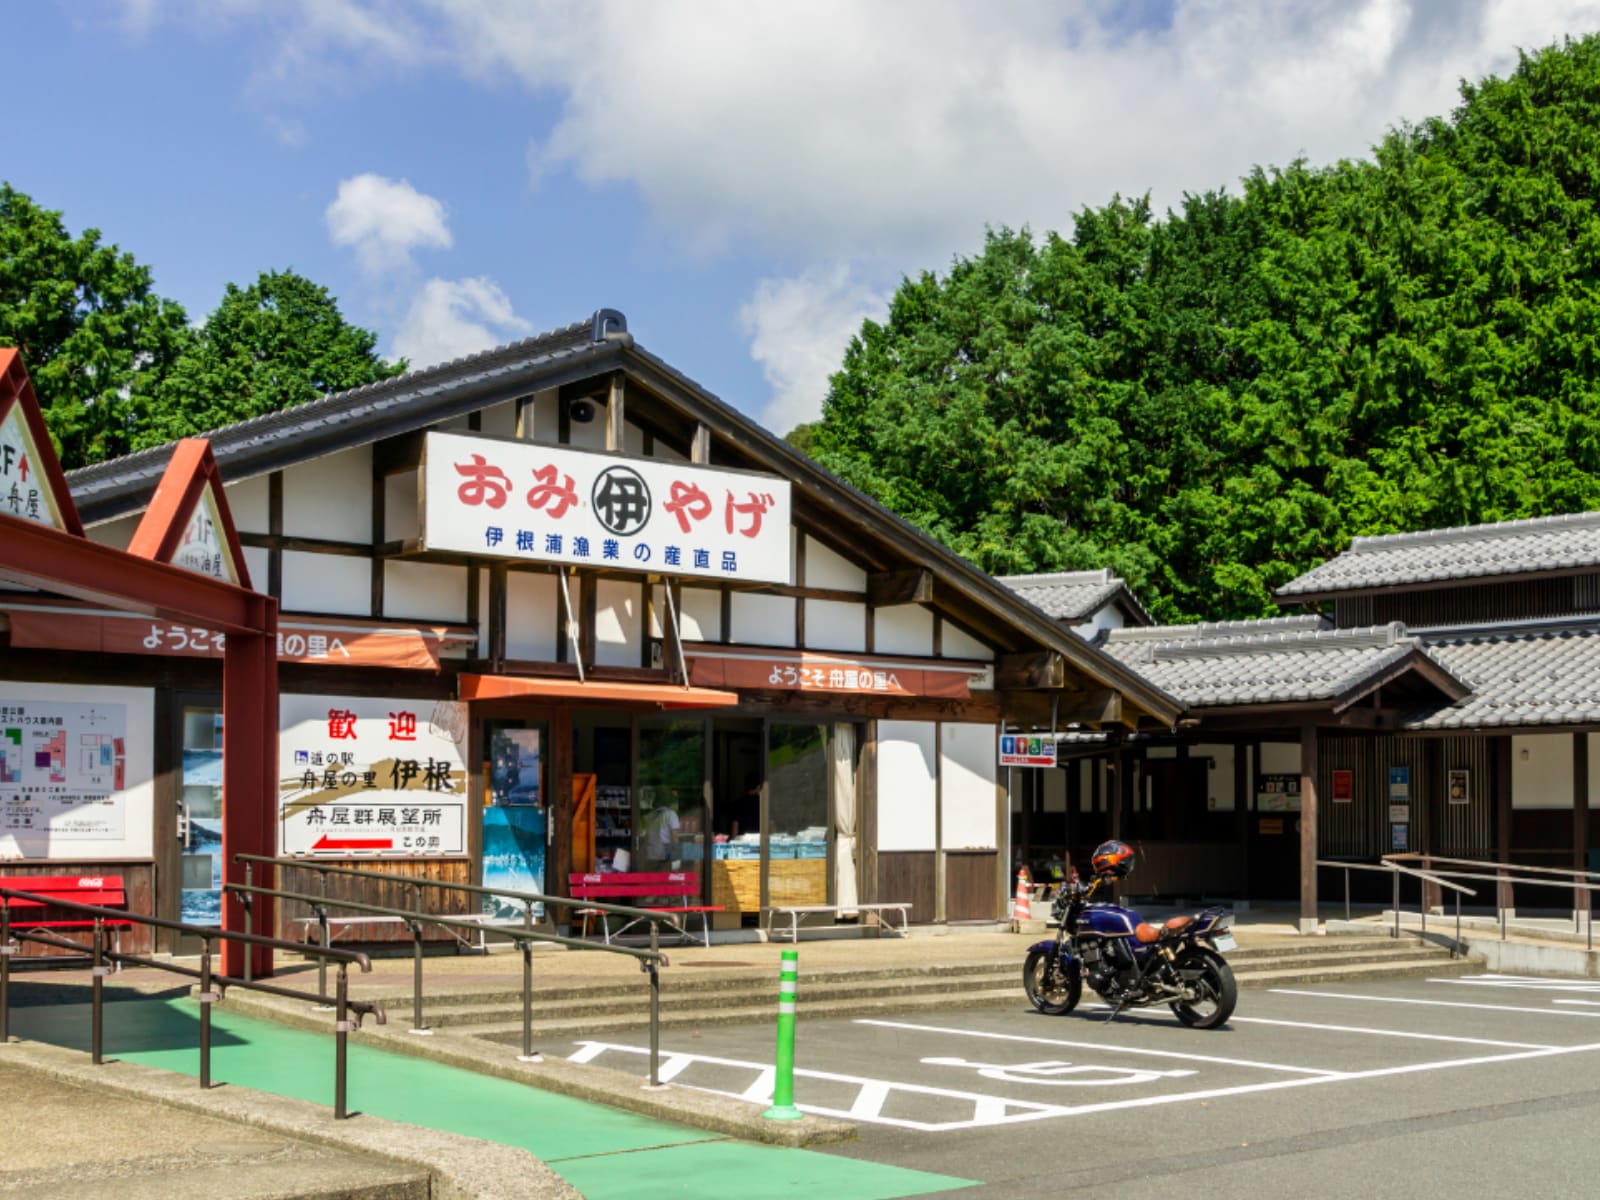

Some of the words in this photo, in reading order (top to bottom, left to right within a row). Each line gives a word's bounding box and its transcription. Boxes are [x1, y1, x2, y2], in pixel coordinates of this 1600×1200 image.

[0, 444, 15, 475] F
[485, 526, 738, 572] 伊根浦漁業の産直品
[277, 633, 350, 658] の里へ
[769, 665, 826, 688] ようこそ
[328, 709, 417, 741] 歓迎
[311, 751, 354, 766] 道の駅
[302, 769, 377, 790] 舟屋の里
[389, 757, 453, 791] 伊根
[306, 807, 442, 825] 舟屋群展望所
